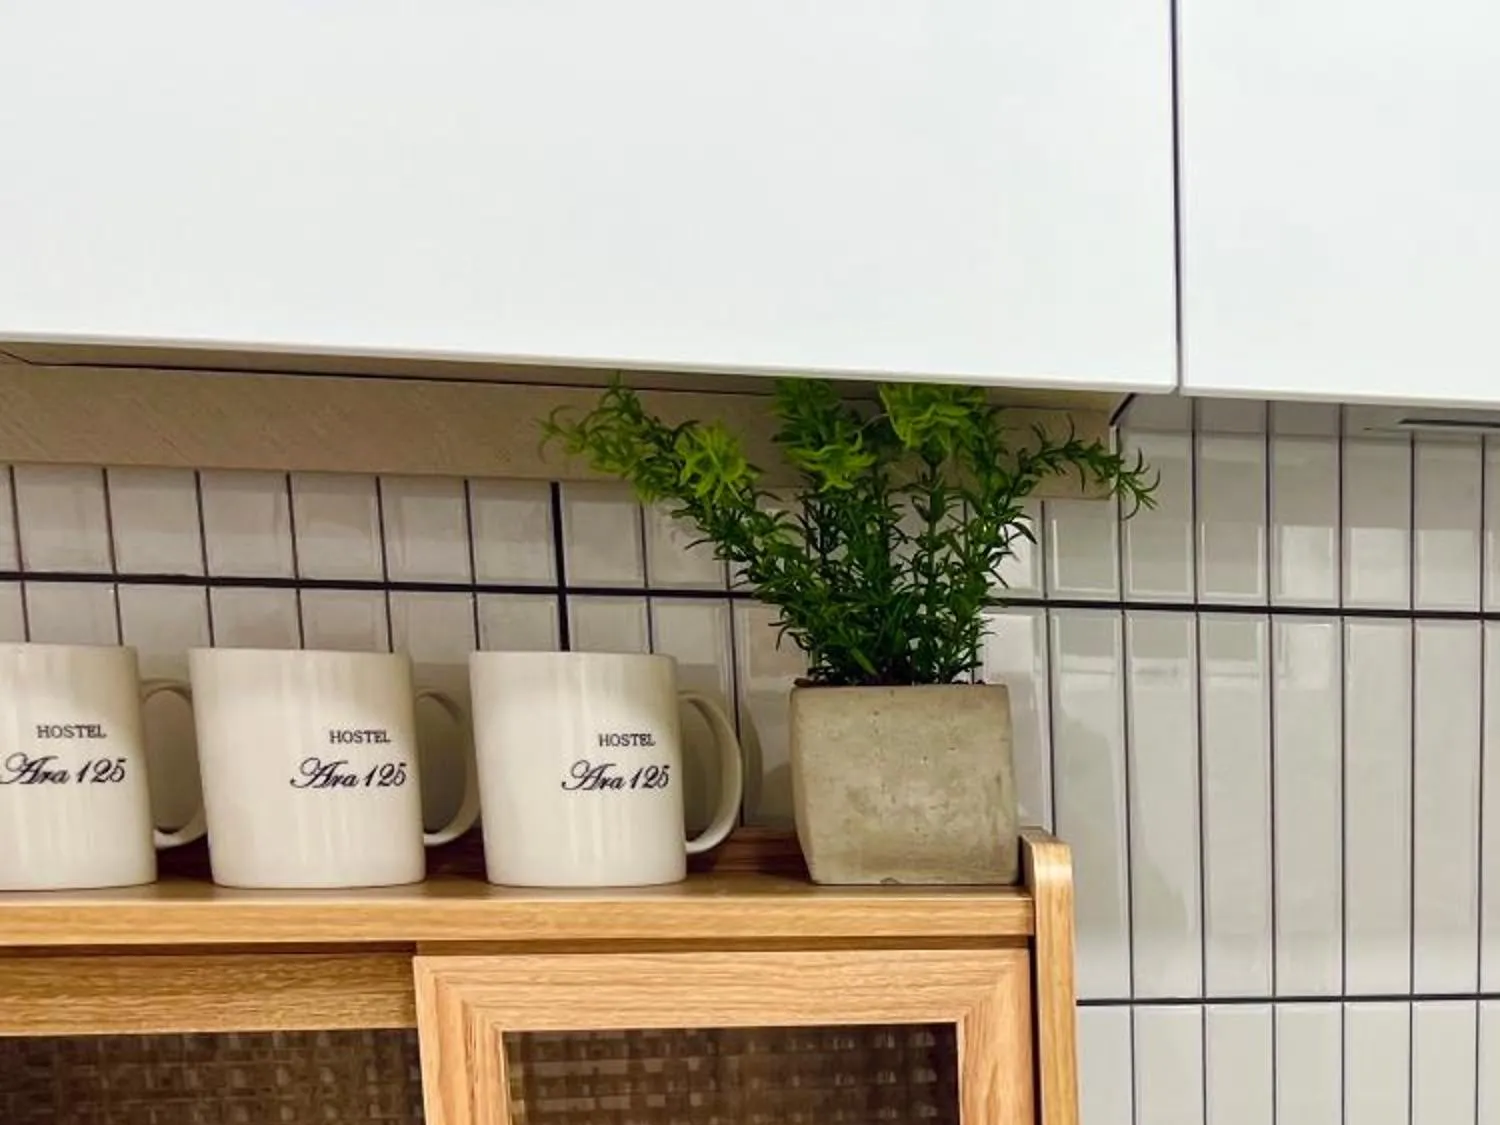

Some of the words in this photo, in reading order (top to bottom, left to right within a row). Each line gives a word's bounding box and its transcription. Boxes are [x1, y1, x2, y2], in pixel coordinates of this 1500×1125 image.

[36, 724, 107, 739] HOSTEL
[329, 729, 391, 744] HOSTEL
[598, 733, 656, 747] HOSTEL
[0, 752, 70, 784] Ara
[76, 757, 127, 784] 125
[290, 757, 359, 788] Ara
[364, 762, 407, 787] 125
[562, 760, 625, 790] Ara
[629, 764, 670, 789] 125
